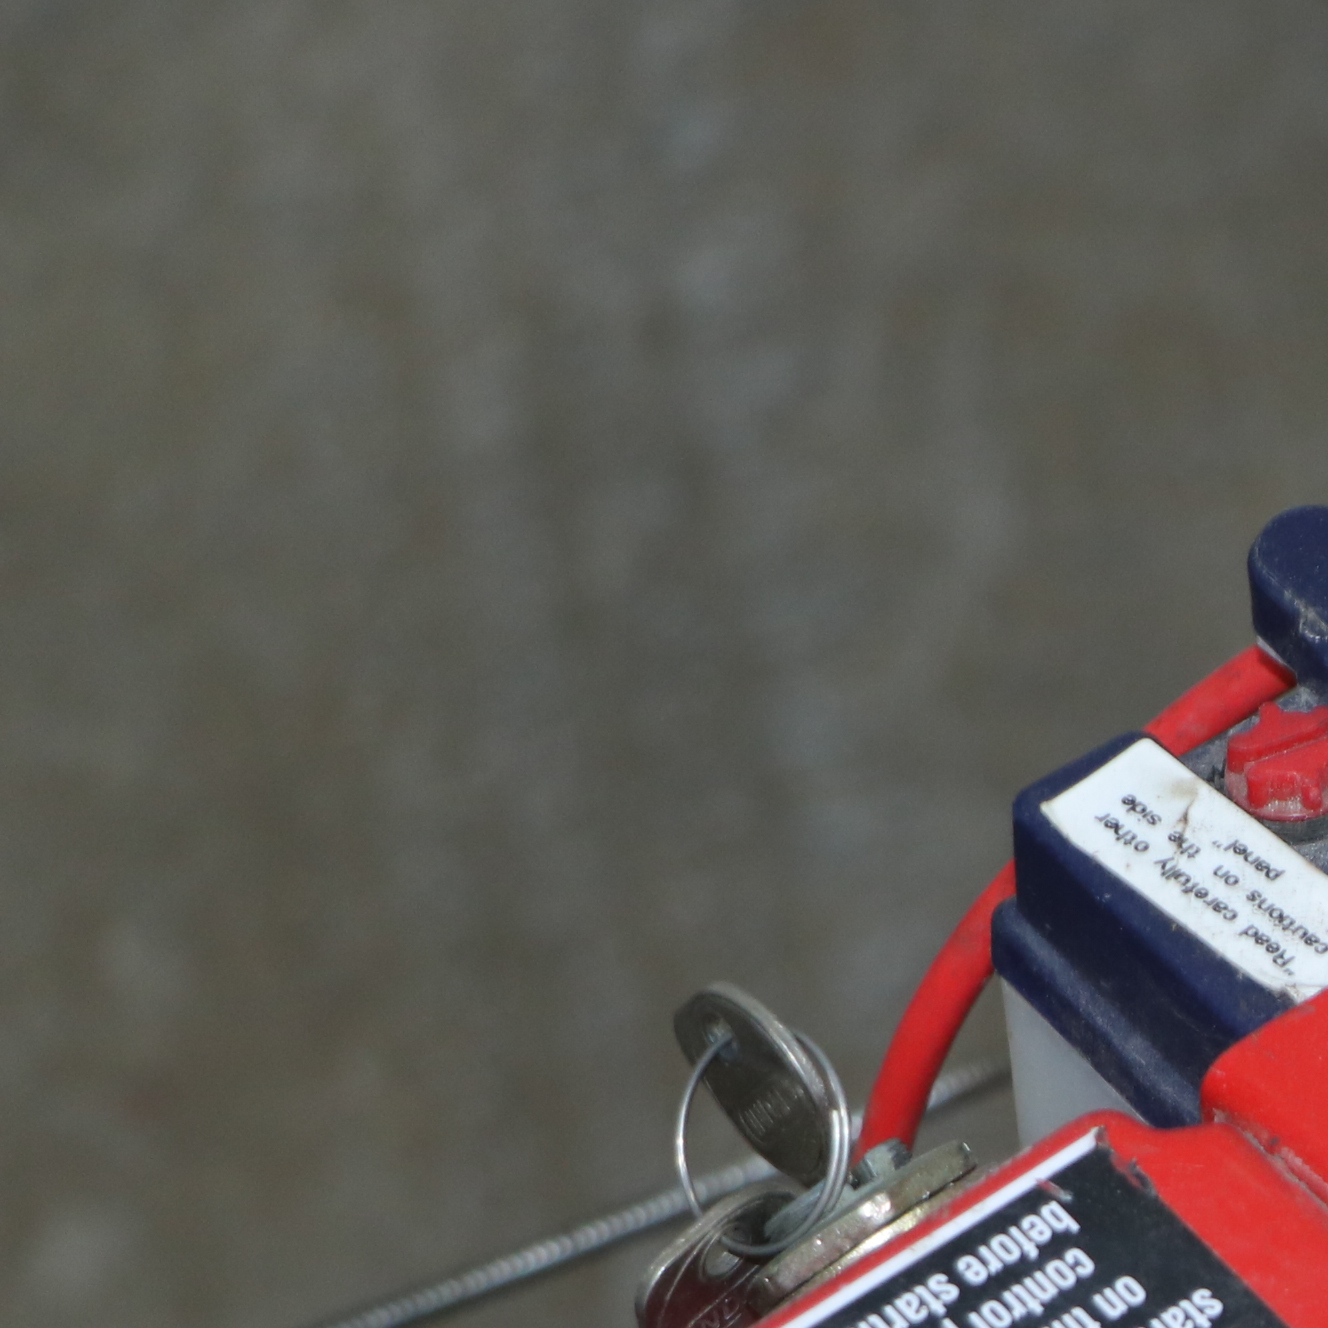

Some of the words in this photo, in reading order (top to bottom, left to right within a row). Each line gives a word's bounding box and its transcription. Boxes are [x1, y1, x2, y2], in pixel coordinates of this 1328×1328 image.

[1121, 793, 1163, 827] side
[1094, 814, 1150, 854] other
[1168, 828, 1202, 861] the
[1153, 856, 1238, 922] carefully
[1213, 865, 1239, 887] on
[955, 1199, 1080, 1285] before
[1091, 1274, 1146, 1320] on
